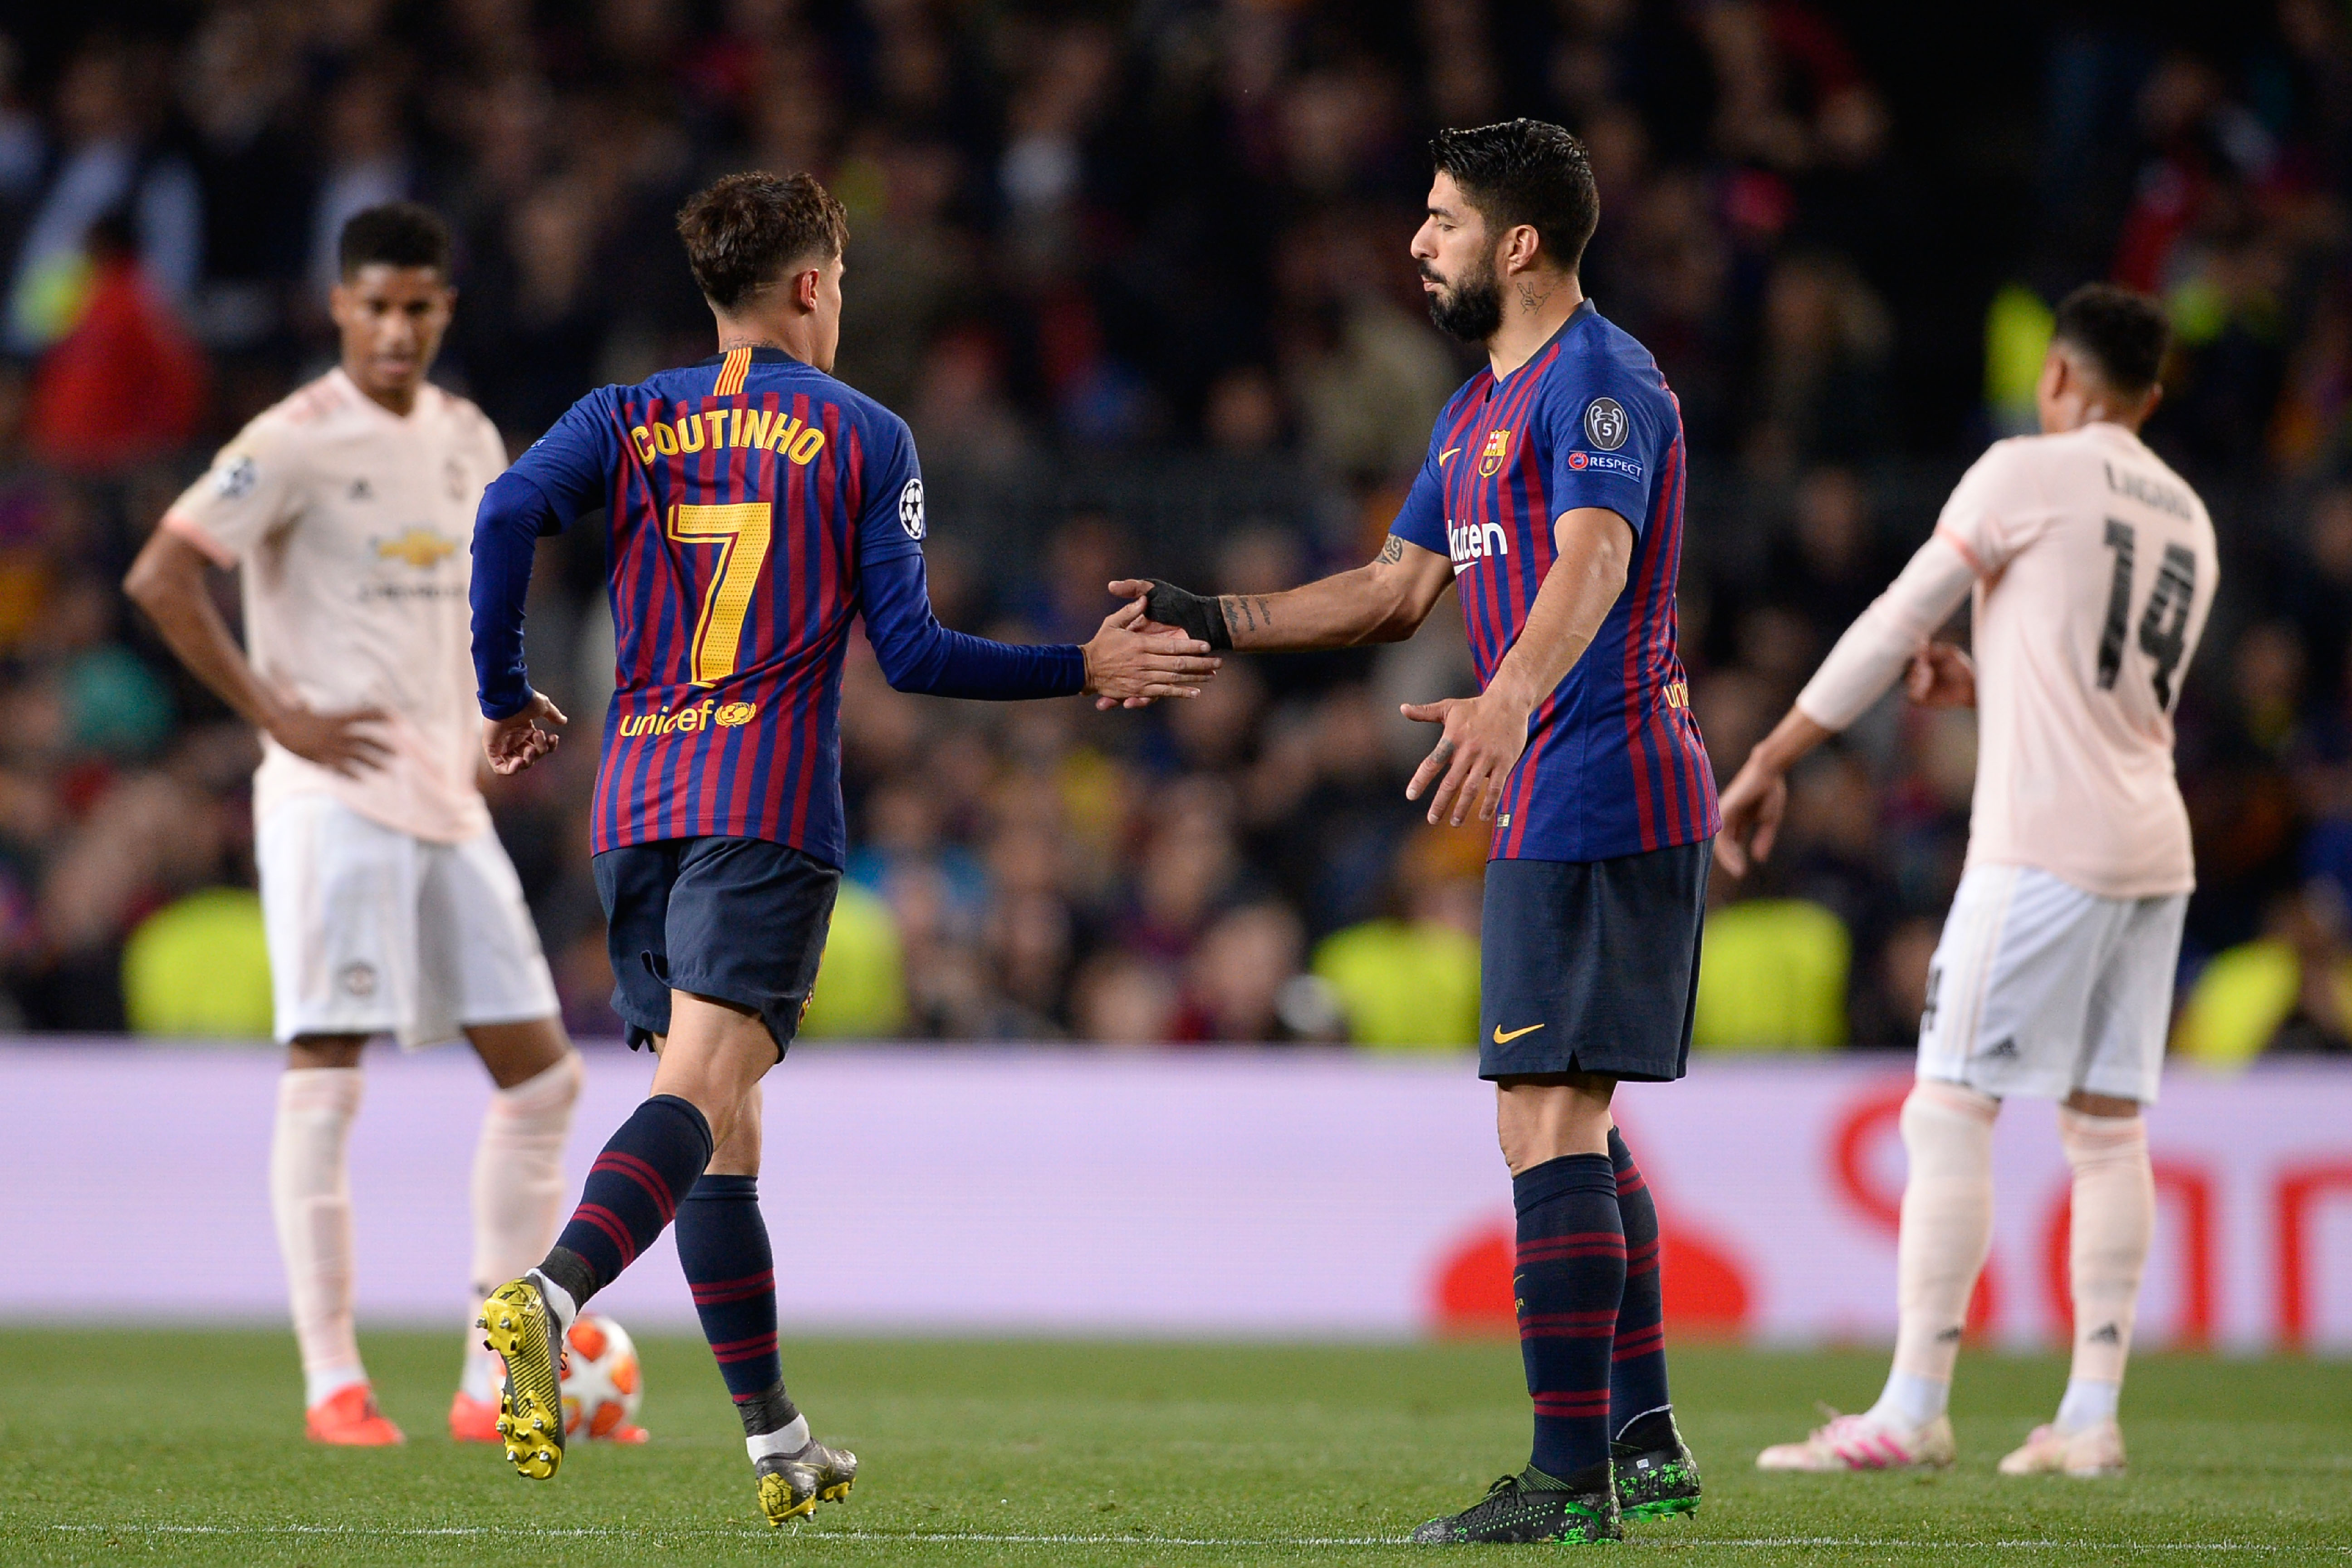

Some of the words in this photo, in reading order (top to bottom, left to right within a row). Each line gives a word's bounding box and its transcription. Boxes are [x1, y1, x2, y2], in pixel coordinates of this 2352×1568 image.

[631, 409, 825, 465] COUTINHO
[1602, 423, 1612, 436] 5
[1590, 457, 1642, 477] RESPECT
[668, 502, 771, 688] 7
[2097, 518, 2196, 712] 14
[619, 699, 715, 737] unicef
